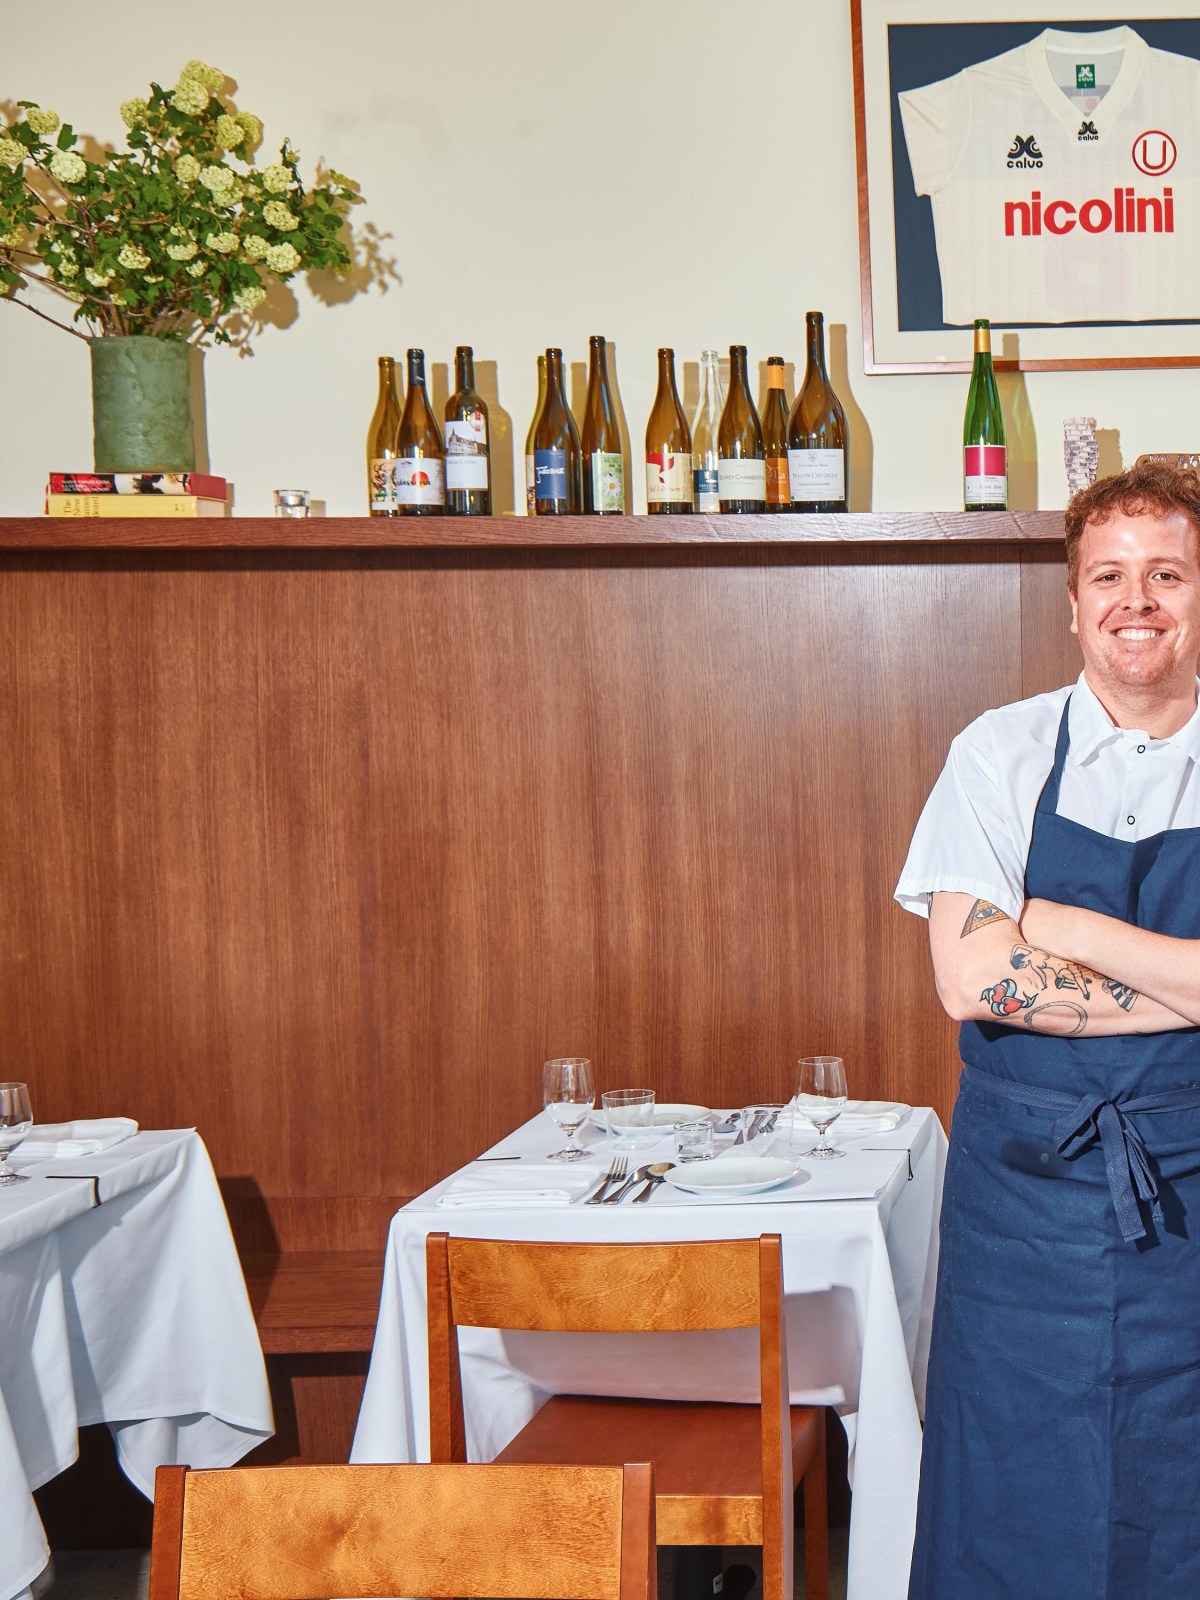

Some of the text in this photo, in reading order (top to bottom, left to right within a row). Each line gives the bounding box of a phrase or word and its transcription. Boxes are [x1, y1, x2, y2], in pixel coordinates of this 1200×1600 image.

[1006, 157, 1044, 169] calvo
[1142, 139, 1167, 170] U
[1004, 187, 1175, 236] nicolini
